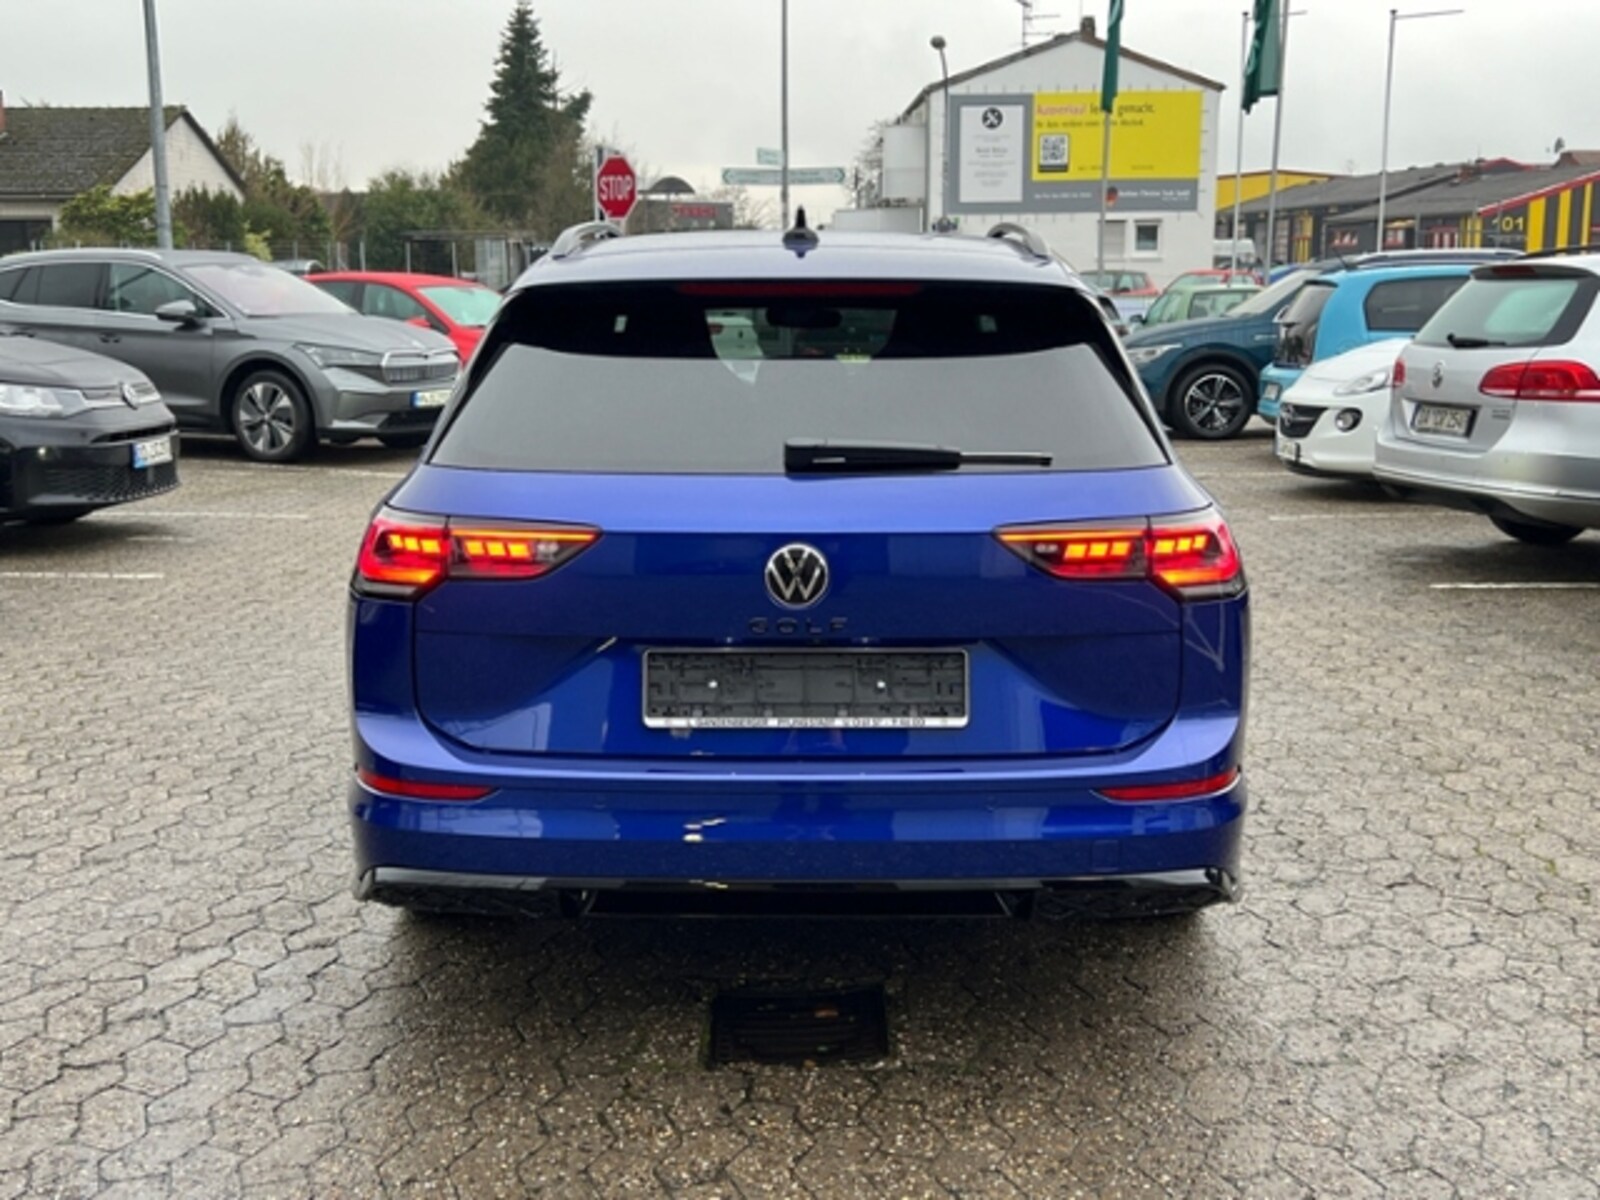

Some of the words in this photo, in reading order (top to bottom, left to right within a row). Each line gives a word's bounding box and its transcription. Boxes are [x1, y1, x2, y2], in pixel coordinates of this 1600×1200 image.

[599, 176, 633, 201] STOP
[1491, 216, 1524, 232] 101
[748, 616, 849, 634] GOLF
